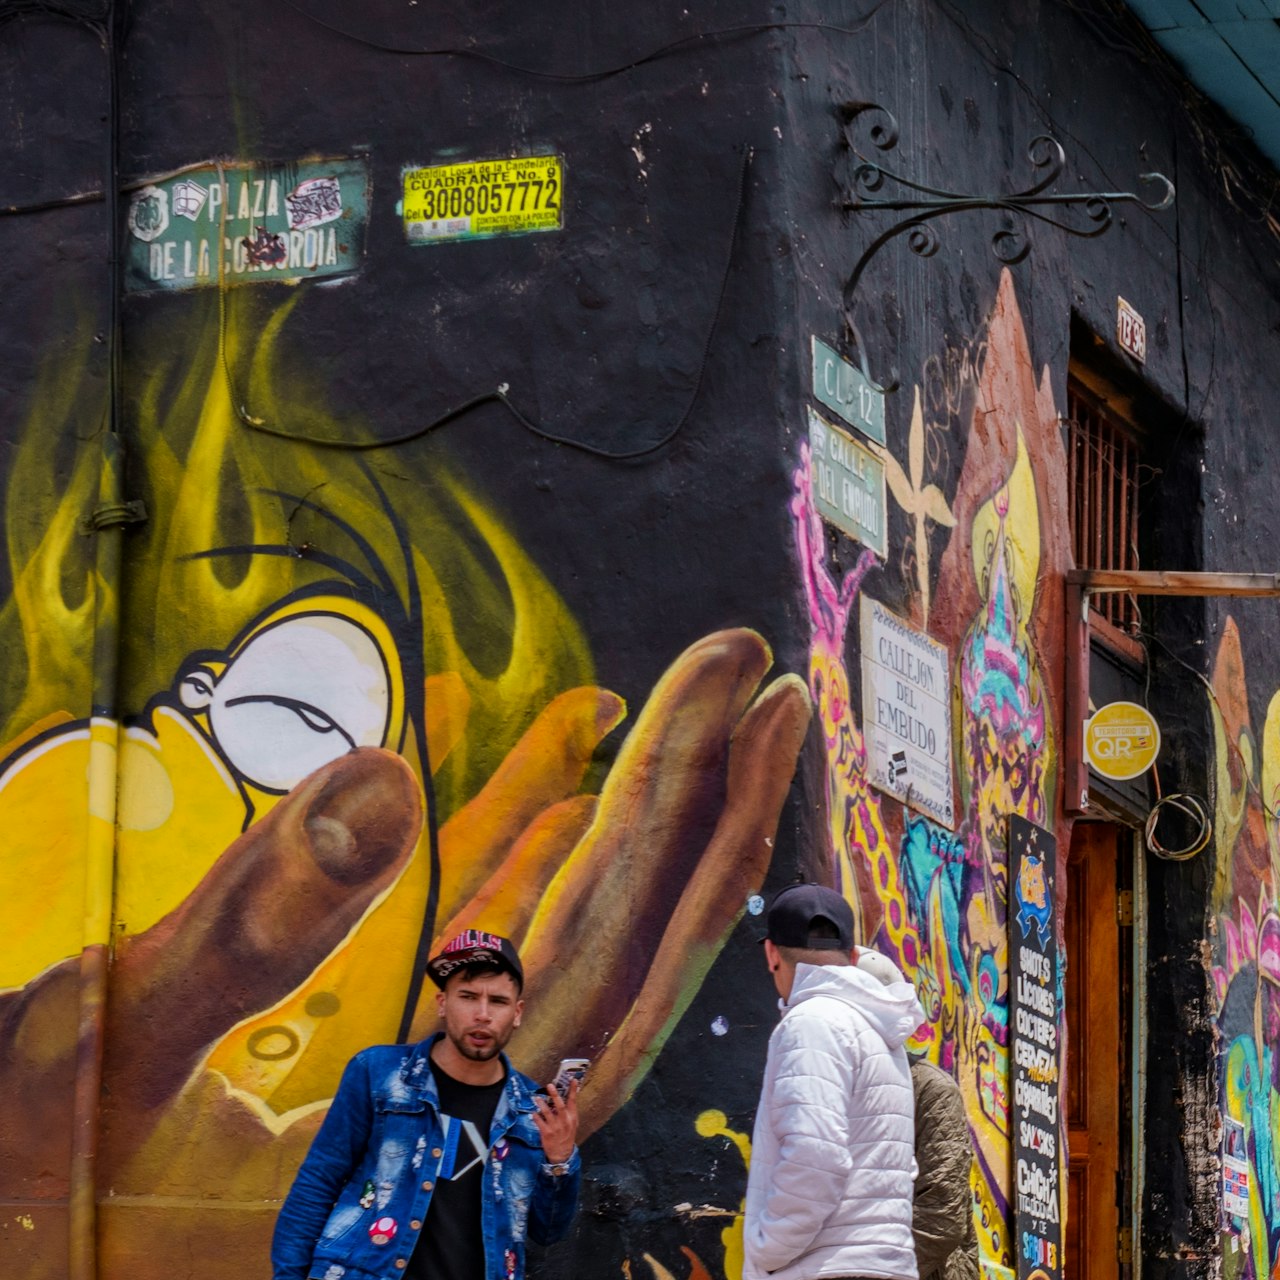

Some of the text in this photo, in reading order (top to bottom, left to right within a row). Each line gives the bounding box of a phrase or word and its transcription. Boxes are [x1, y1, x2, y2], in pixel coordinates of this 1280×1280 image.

[410, 167, 556, 190] CUADRANTE No. 9
[450, 163, 476, 177] Local
[479, 162, 491, 174] de
[493, 161, 503, 172] la
[208, 179, 279, 222] PLAZA
[423, 178, 559, 220] 3008057772
[150, 241, 176, 282] DE
[183, 238, 210, 279] LA
[830, 433, 866, 491] CALLE
[818, 471, 879, 538] DEL EMBUDO
[879, 636, 936, 694] CALLEJON
[896, 680, 918, 711] DEL
[877, 696, 936, 757] EMBUDO
[1094, 738, 1134, 759] QR
